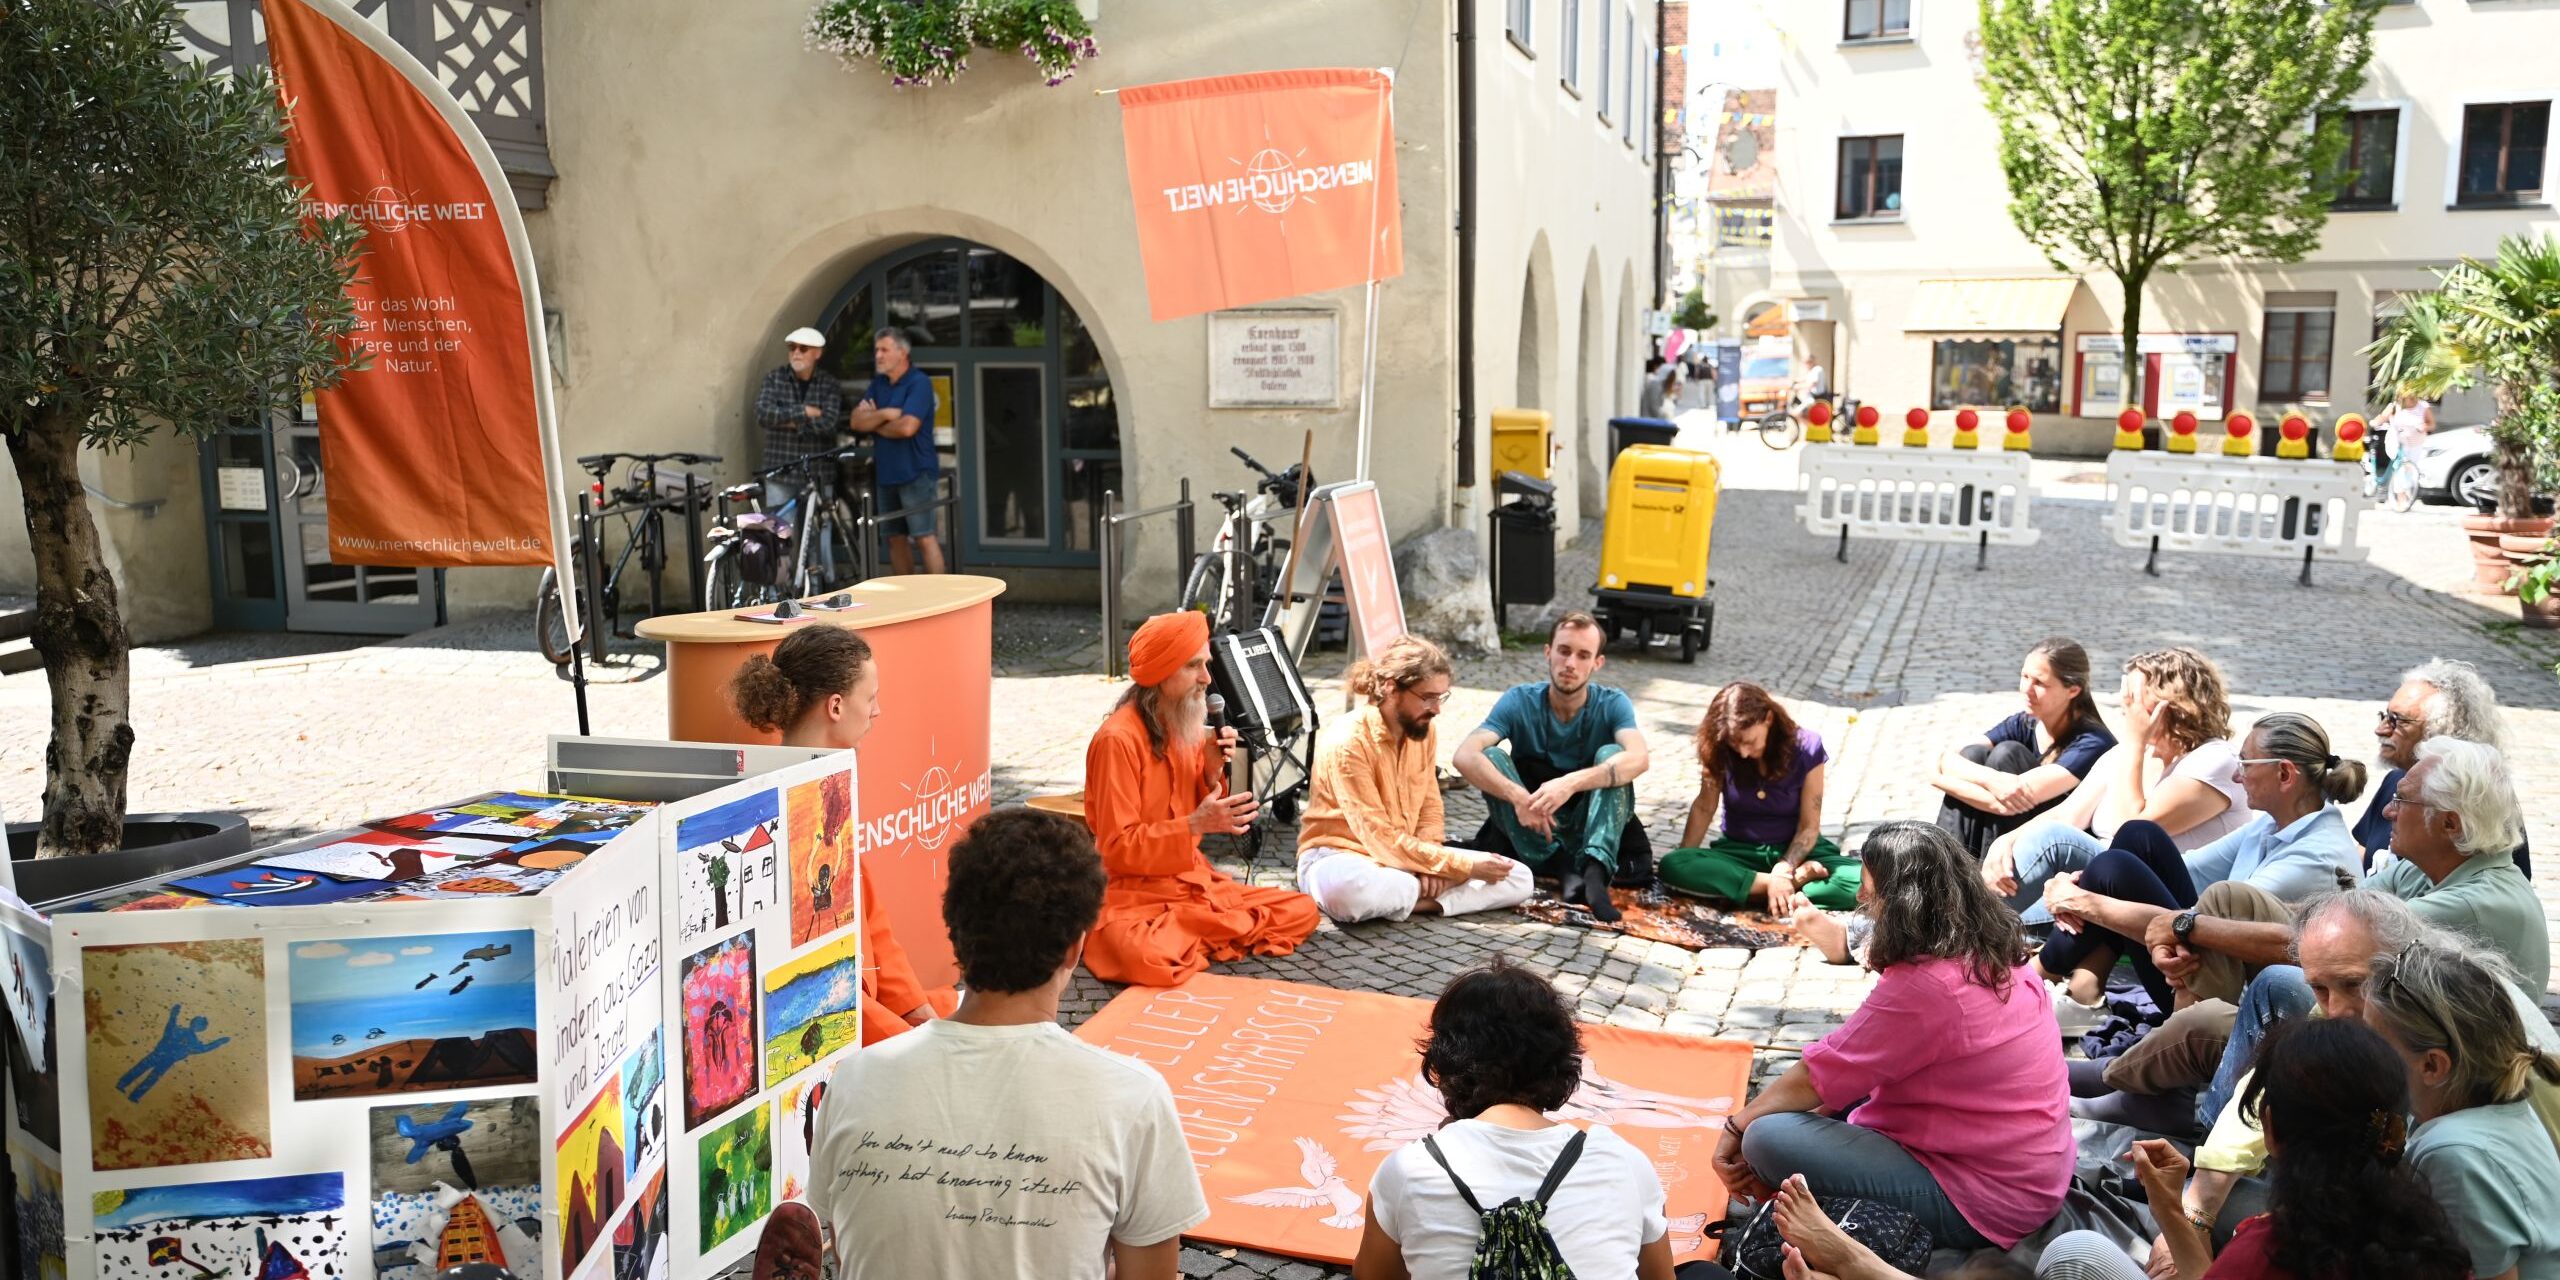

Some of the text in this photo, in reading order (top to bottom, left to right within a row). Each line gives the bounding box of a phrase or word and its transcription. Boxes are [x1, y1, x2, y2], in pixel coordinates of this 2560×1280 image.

[433, 202, 486, 220] WELT
[381, 297, 407, 311] das
[411, 296, 455, 311] Wohl
[383, 317, 472, 333] Menschen,
[349, 338, 462, 352] Tiere und der
[385, 359, 438, 373] Natur.
[338, 536, 541, 552] www.menschlichewelt.de
[858, 784, 968, 854] ENSCHLICHE
[627, 885, 648, 930] von
[554, 936, 658, 1067] indern aus Gaza
[564, 1047, 588, 1110] und
[854, 1131, 1049, 1163] You don't need to know
[839, 1161, 889, 1192] nything,
[936, 1170, 1012, 1199] knowing
[1018, 1177, 1082, 1195] itself
